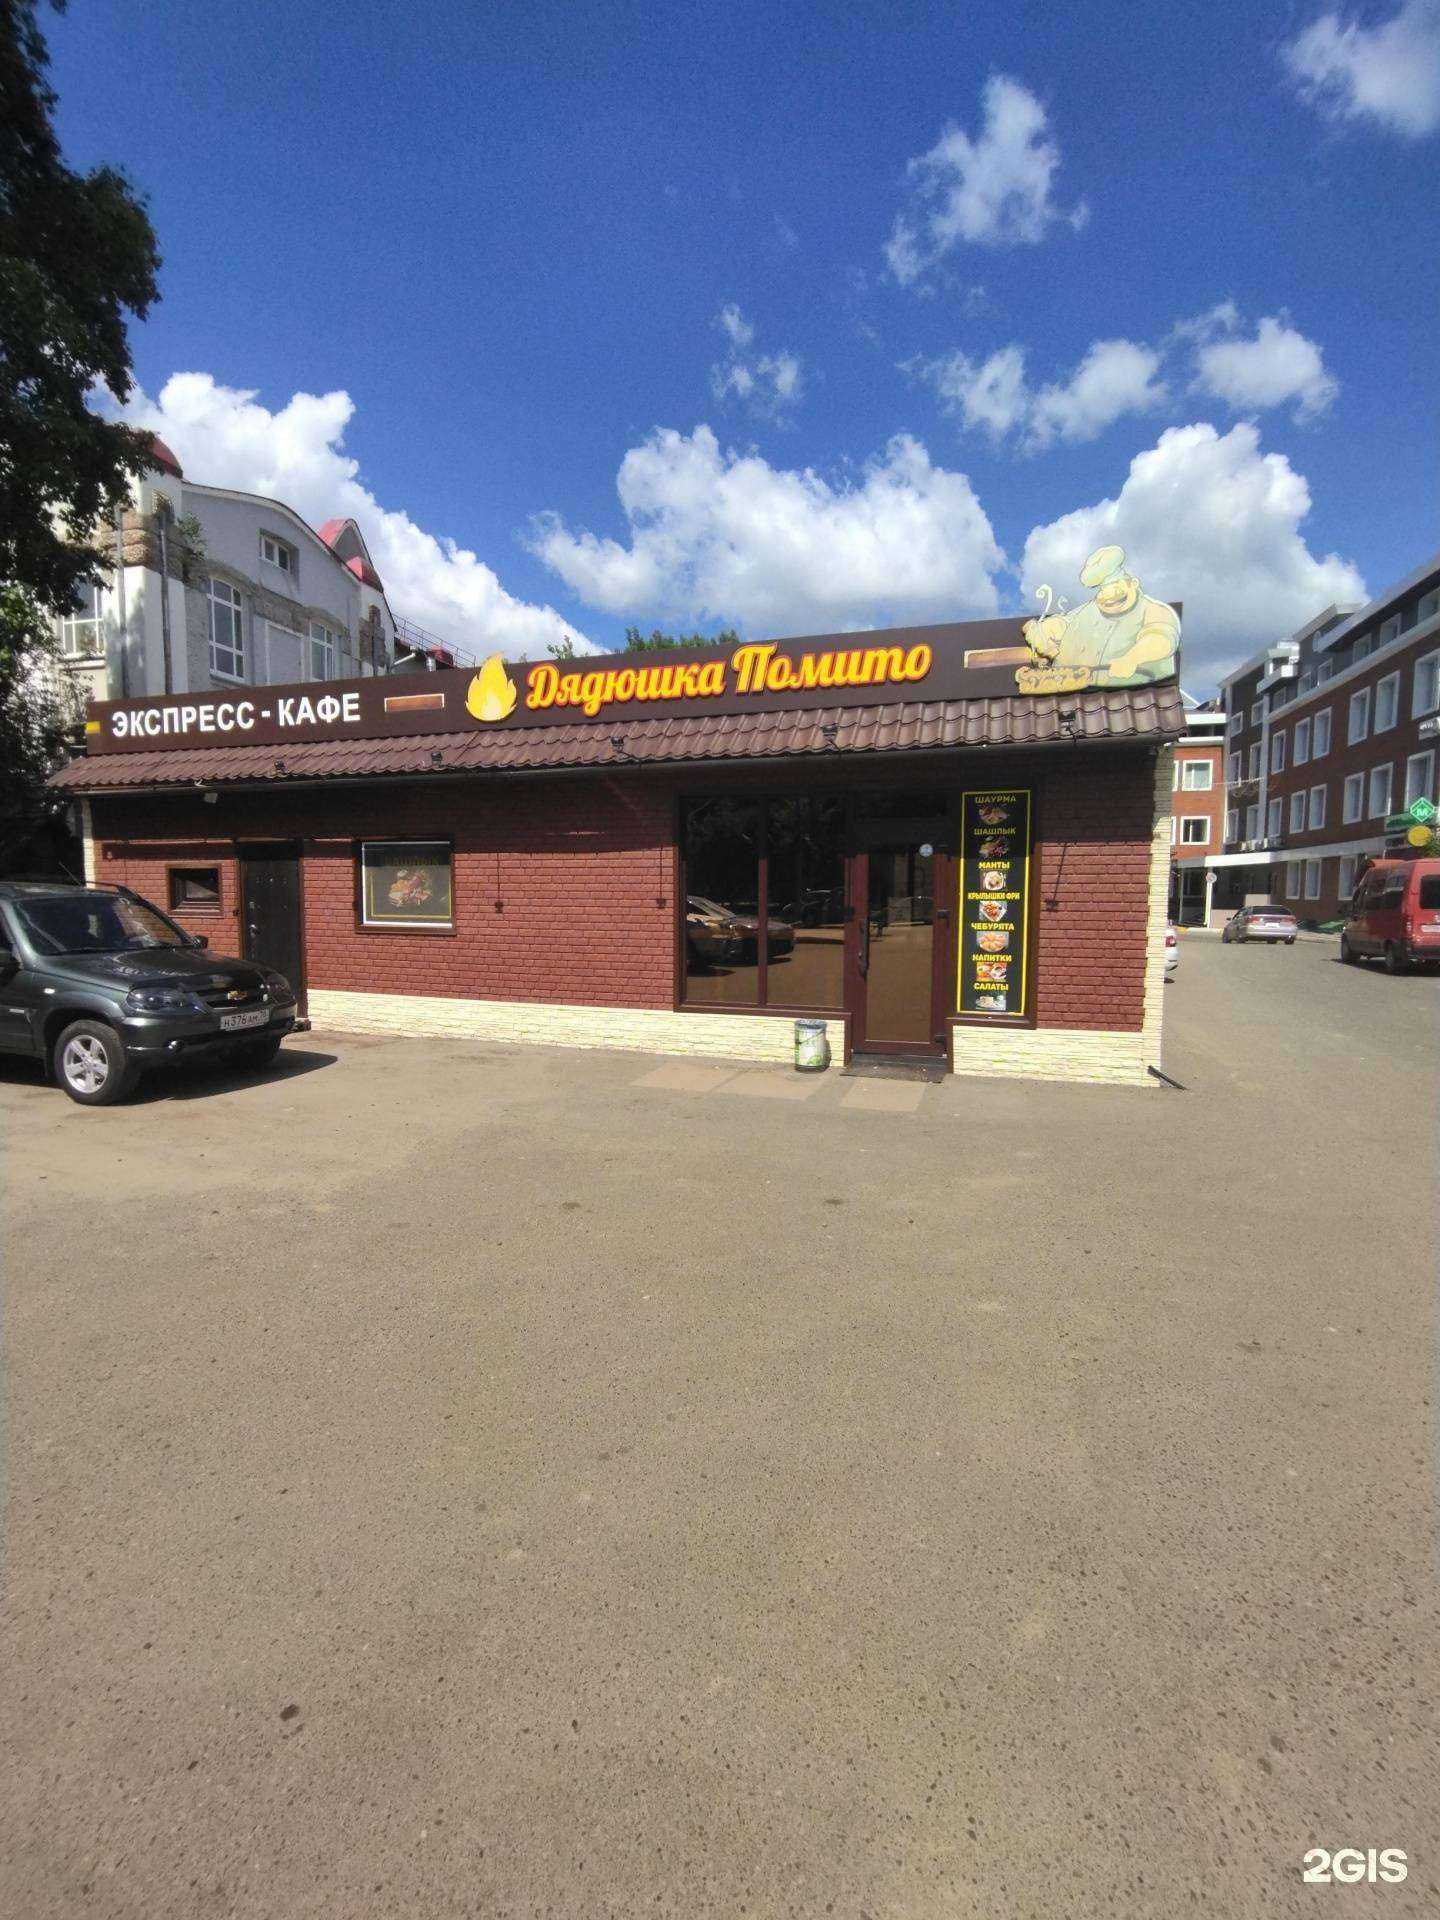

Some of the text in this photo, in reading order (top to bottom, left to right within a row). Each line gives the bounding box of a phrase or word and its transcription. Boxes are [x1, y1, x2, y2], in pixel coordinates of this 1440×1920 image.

[526, 664, 727, 717] Дядюшка
[111, 700, 255, 738] ЭКСПРЕСС
[278, 692, 361, 727] КАФЕ
[975, 795, 1017, 804] ШАУРМА
[974, 827, 1016, 836] ШАШЛЫК
[978, 861, 1010, 870] МАНТЫ
[968, 892, 1005, 900] КРЫЛЫШКИ
[972, 953, 1012, 962] НАПИТКИ
[974, 982, 1009, 991] САЛАТЫ
